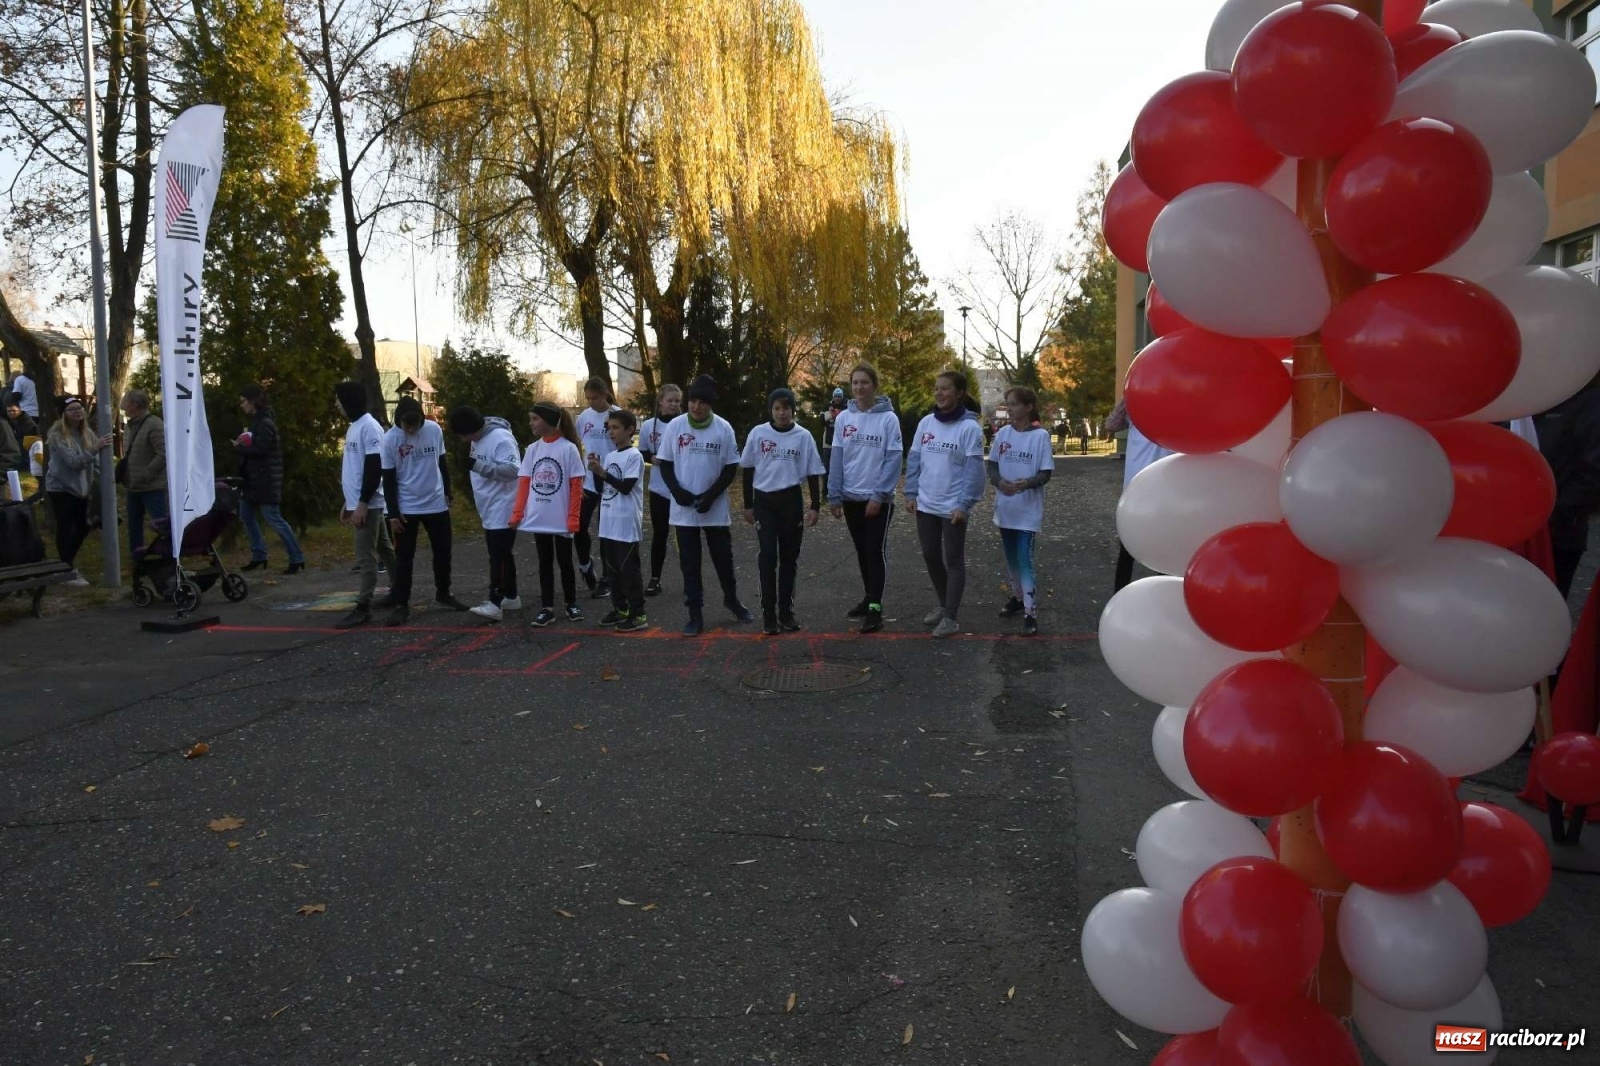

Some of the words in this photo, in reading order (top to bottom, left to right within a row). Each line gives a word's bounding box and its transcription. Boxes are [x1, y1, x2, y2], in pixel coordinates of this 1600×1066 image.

[866, 434, 883, 443] 2021
[705, 442, 721, 450] 2021
[941, 441, 958, 451] 2021
[786, 448, 801, 457] 2021
